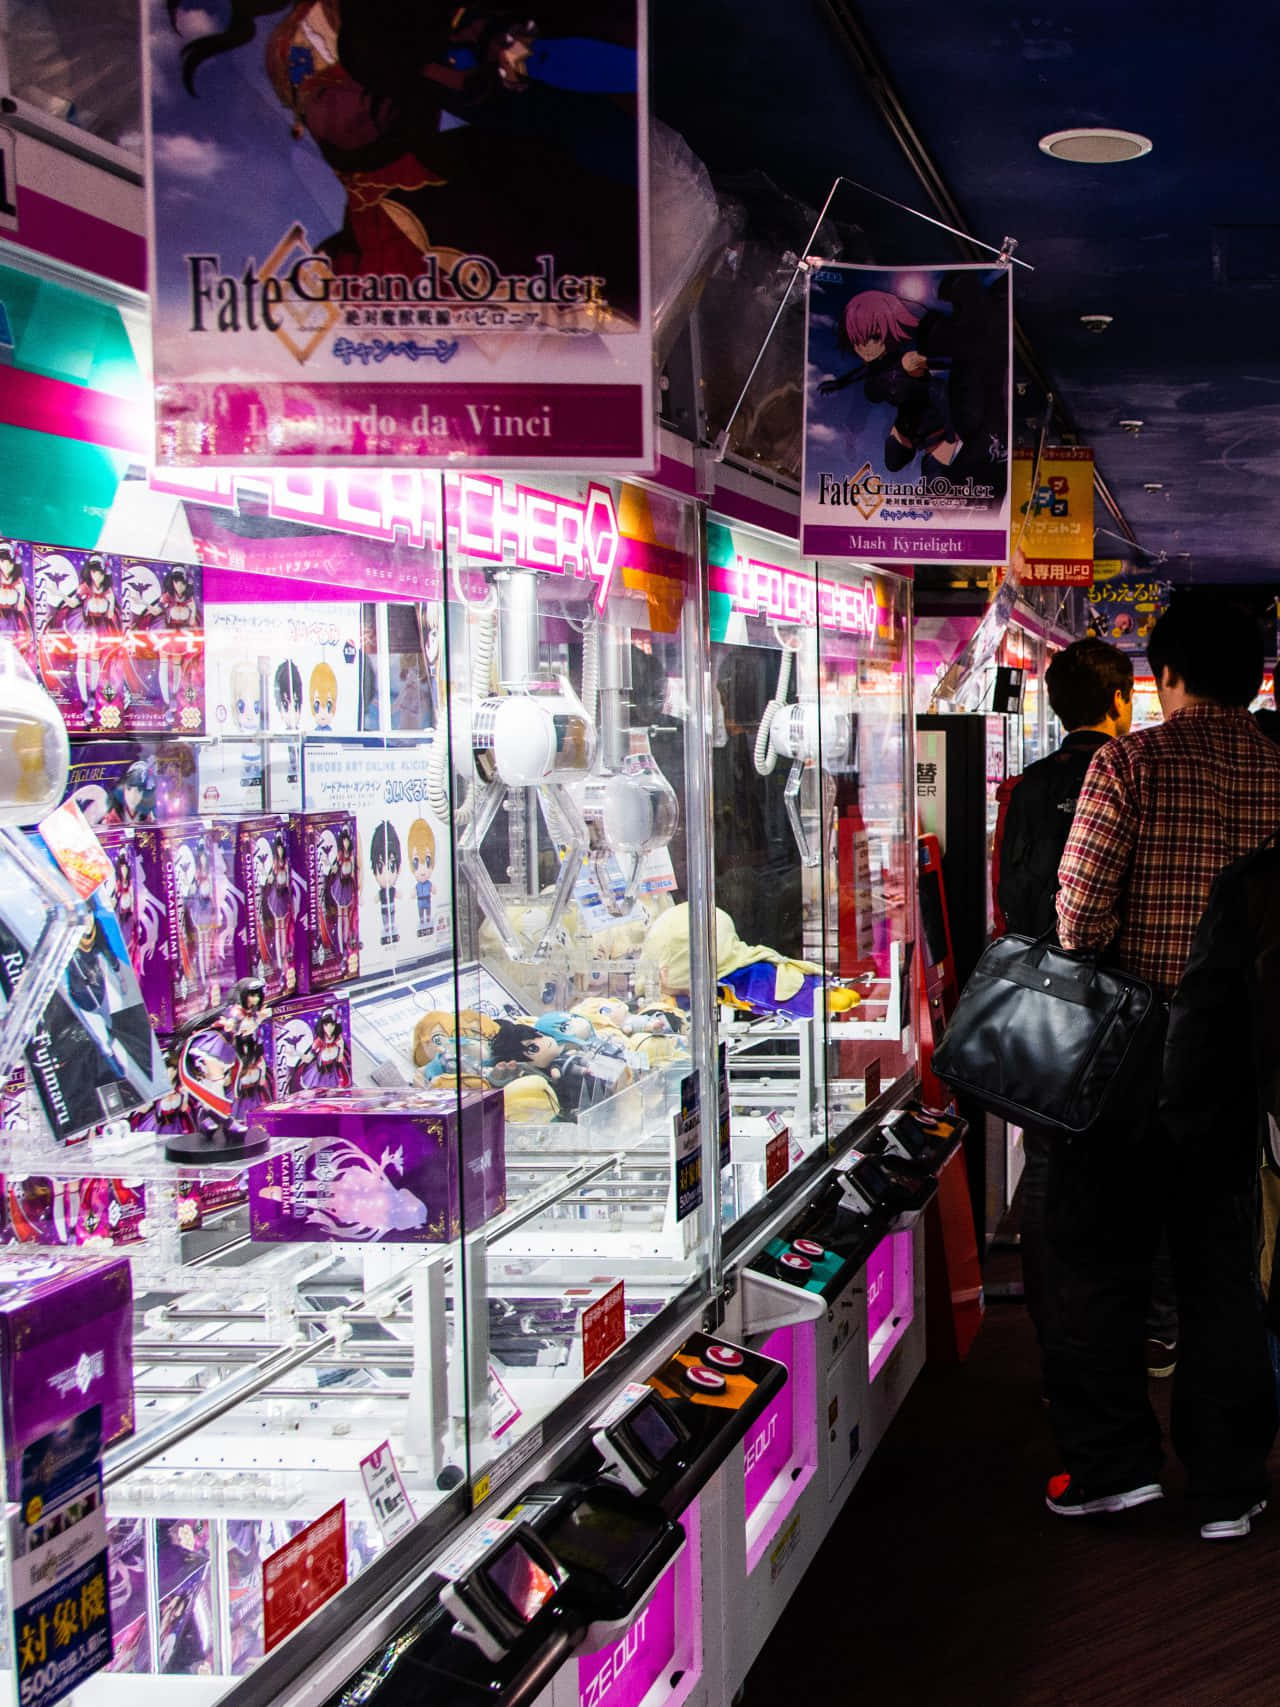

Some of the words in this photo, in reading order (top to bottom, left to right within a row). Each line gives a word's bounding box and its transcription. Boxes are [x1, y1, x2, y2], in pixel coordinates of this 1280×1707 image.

[188, 256, 284, 332] Fate
[288, 254, 448, 302] Grand
[452, 254, 606, 304] Order
[333, 337, 459, 366] キャンペーン
[410, 405, 448, 437] da
[464, 404, 553, 438] Vinci
[819, 473, 860, 506] Fate
[849, 536, 886, 550] Mash
[893, 537, 964, 556] Kyrielight
[1020, 564, 1091, 581] 員専用UFO
[32, 1030, 71, 1126] Fujimaru
